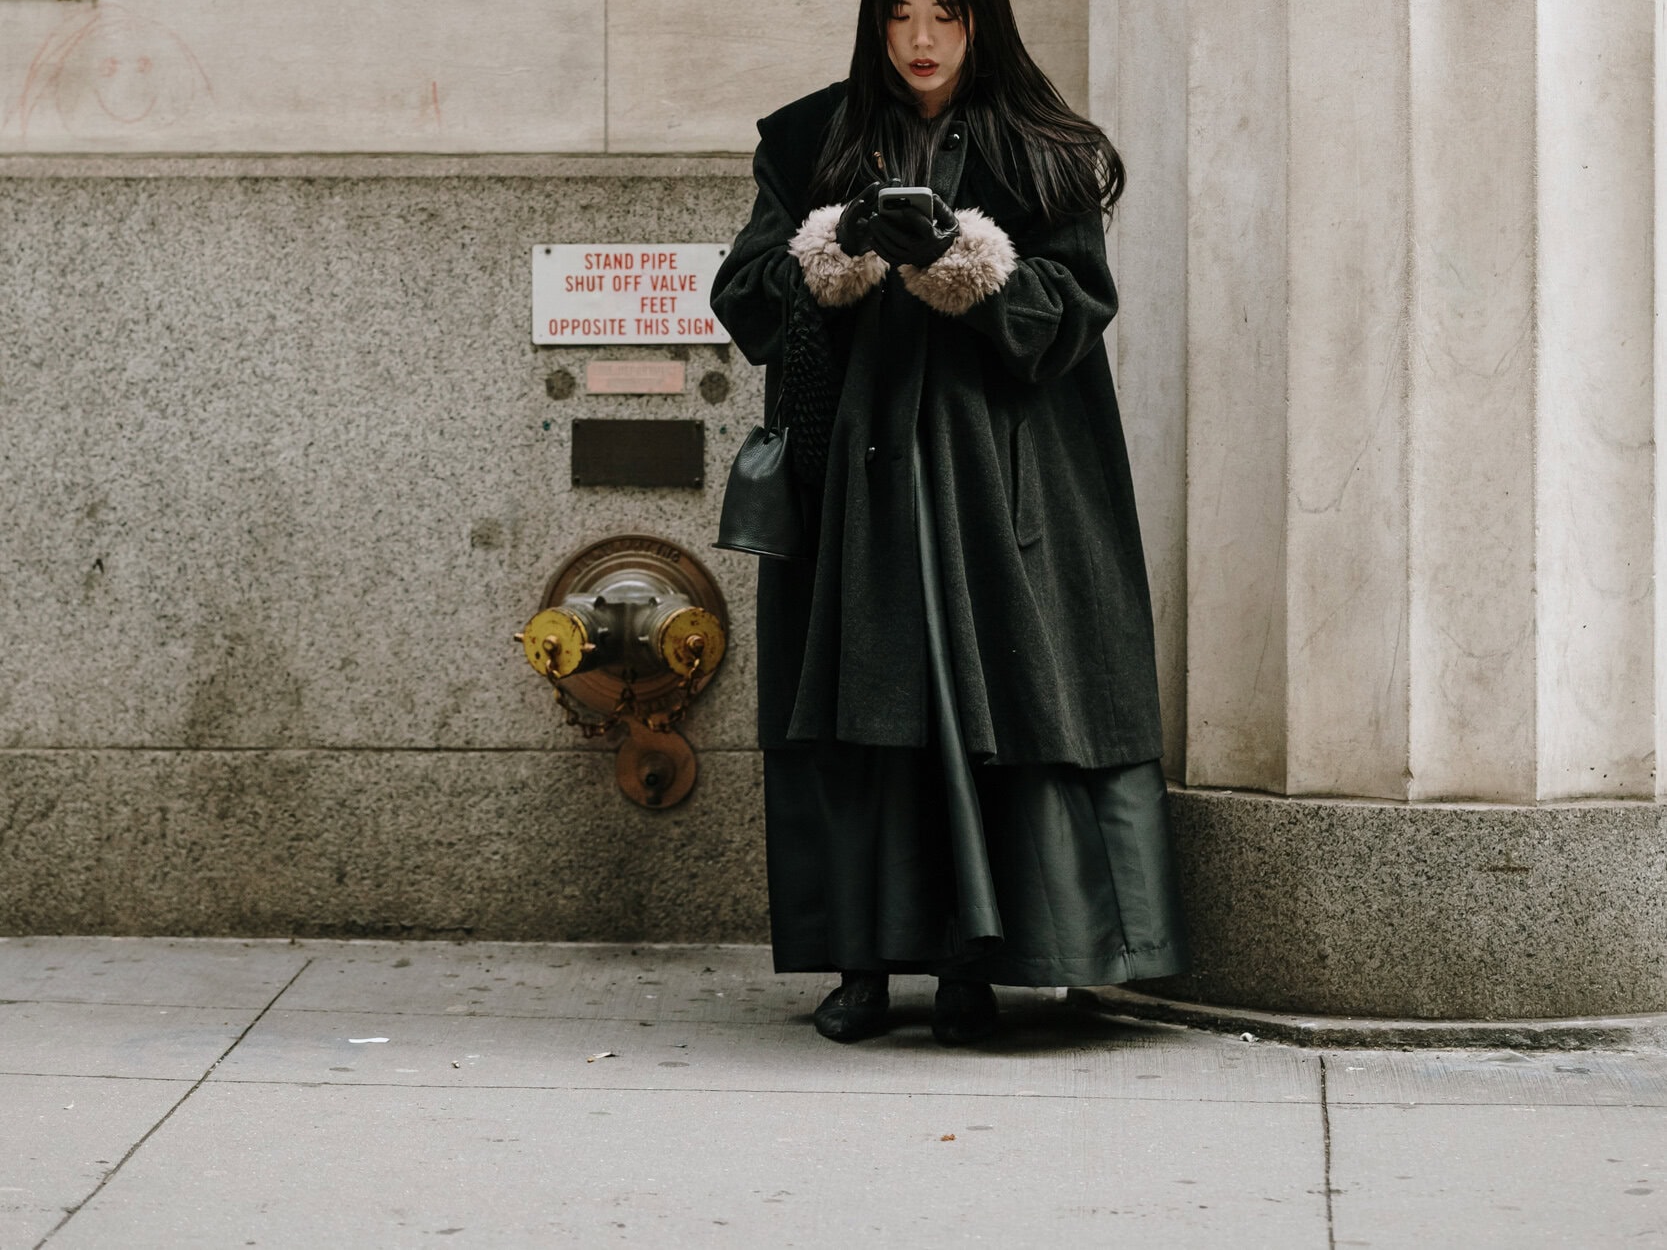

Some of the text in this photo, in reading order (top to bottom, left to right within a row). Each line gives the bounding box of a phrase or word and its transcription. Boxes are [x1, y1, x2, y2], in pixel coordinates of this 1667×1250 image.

[585, 253, 677, 270] STAND PIPE
[566, 275, 697, 292] SHUT OFF VALVE
[640, 296, 677, 313] FEET
[549, 318, 714, 335] OPPOSITE THIS SIGN
